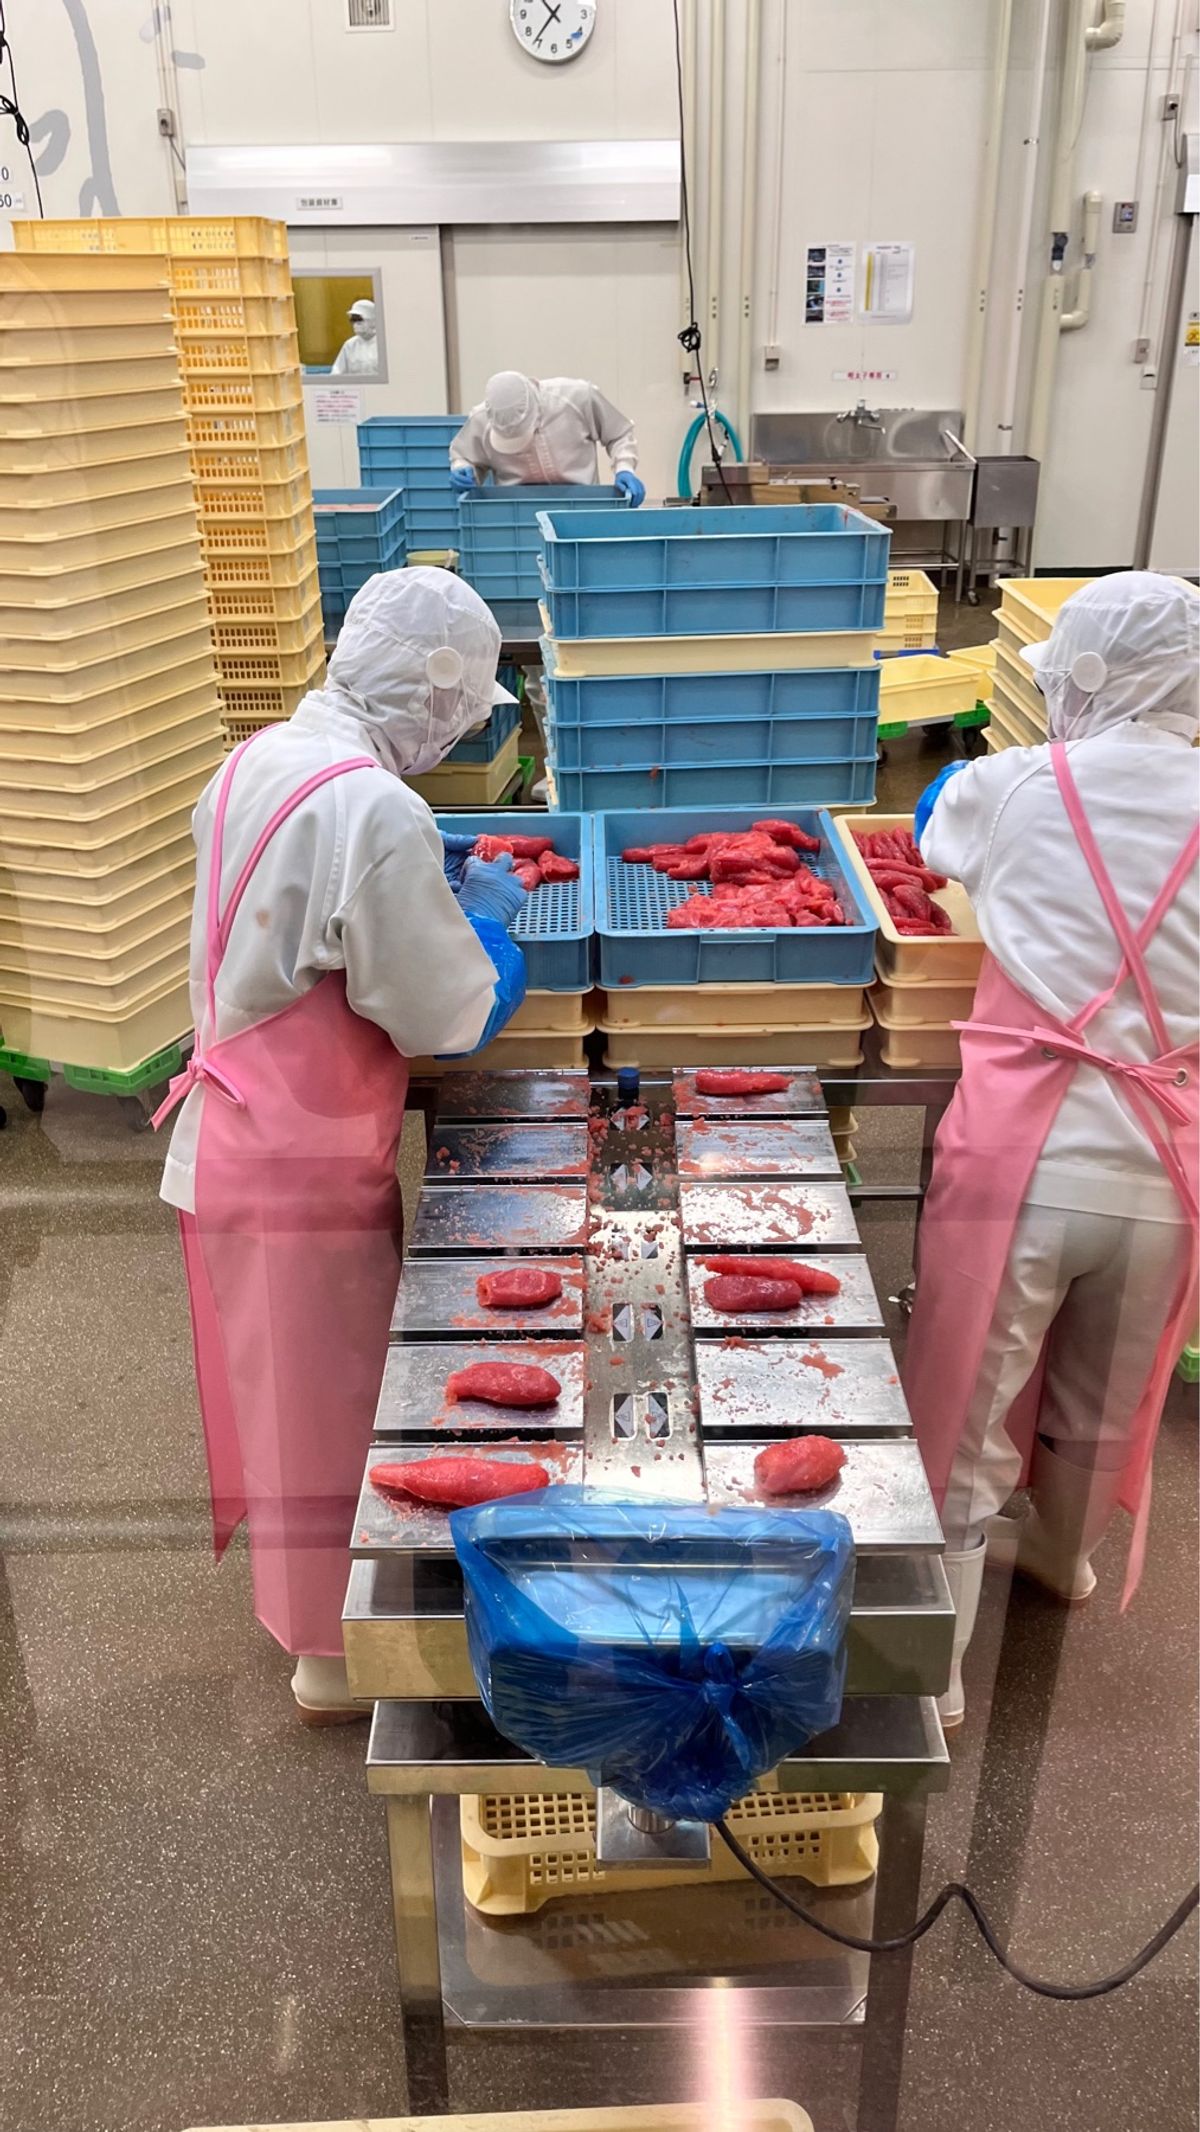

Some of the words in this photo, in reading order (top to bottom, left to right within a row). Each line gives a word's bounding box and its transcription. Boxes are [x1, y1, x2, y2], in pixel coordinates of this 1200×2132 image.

[520, 9, 527, 19] 9
[580, 9, 587, 19] 3
[525, 26, 532, 36] 8
[550, 43, 557, 53] 6
[566, 39, 572, 48] 5
